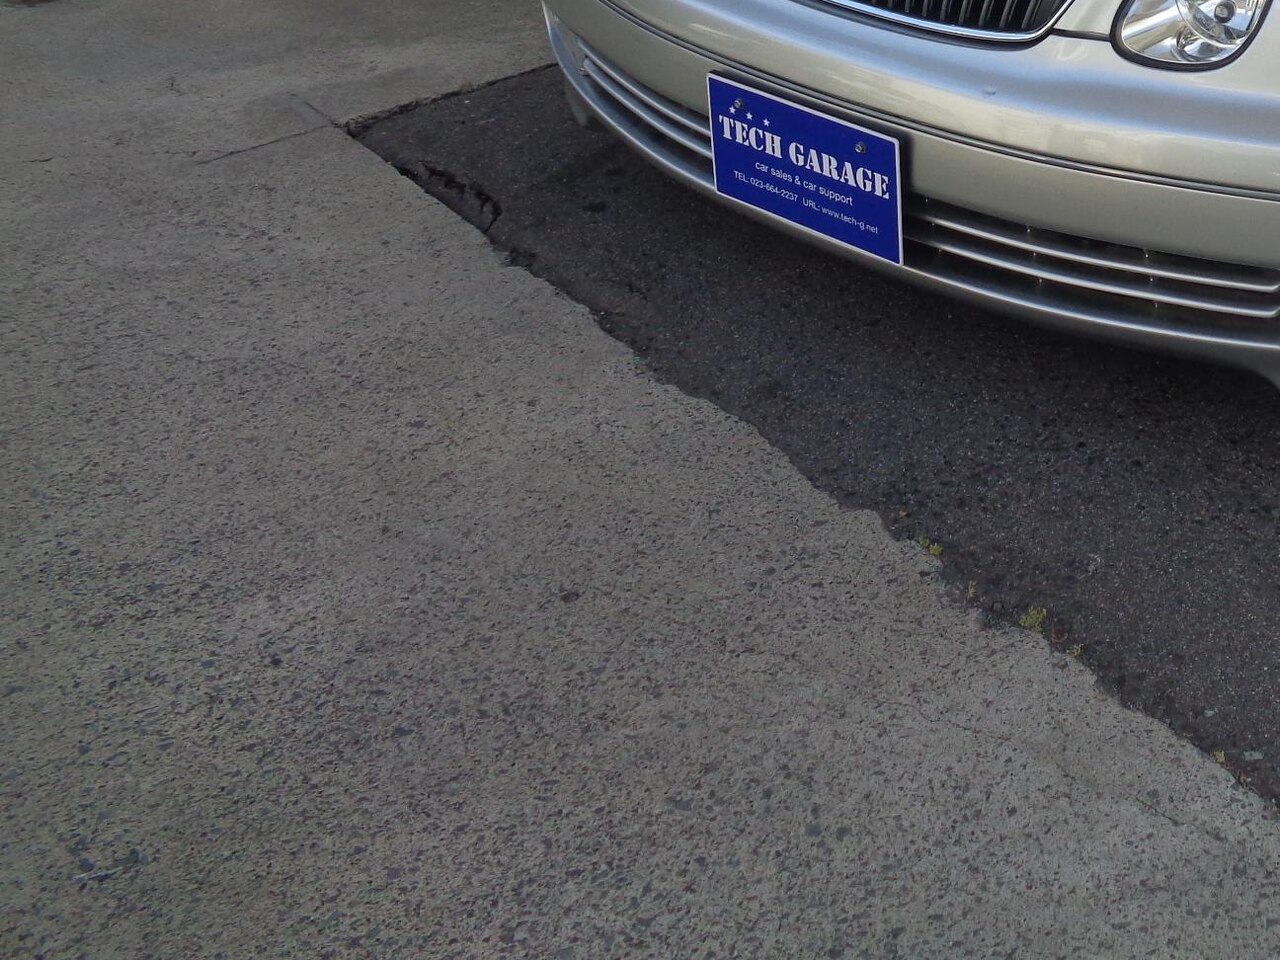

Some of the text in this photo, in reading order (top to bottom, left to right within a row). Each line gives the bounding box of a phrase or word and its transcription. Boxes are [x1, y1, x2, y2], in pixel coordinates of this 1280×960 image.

[719, 115, 890, 200] TECH GARAGE
[755, 161, 853, 207] car sales & car support
[732, 170, 879, 235] TEL: 023-664-2237 URL: www.tech-g.net
